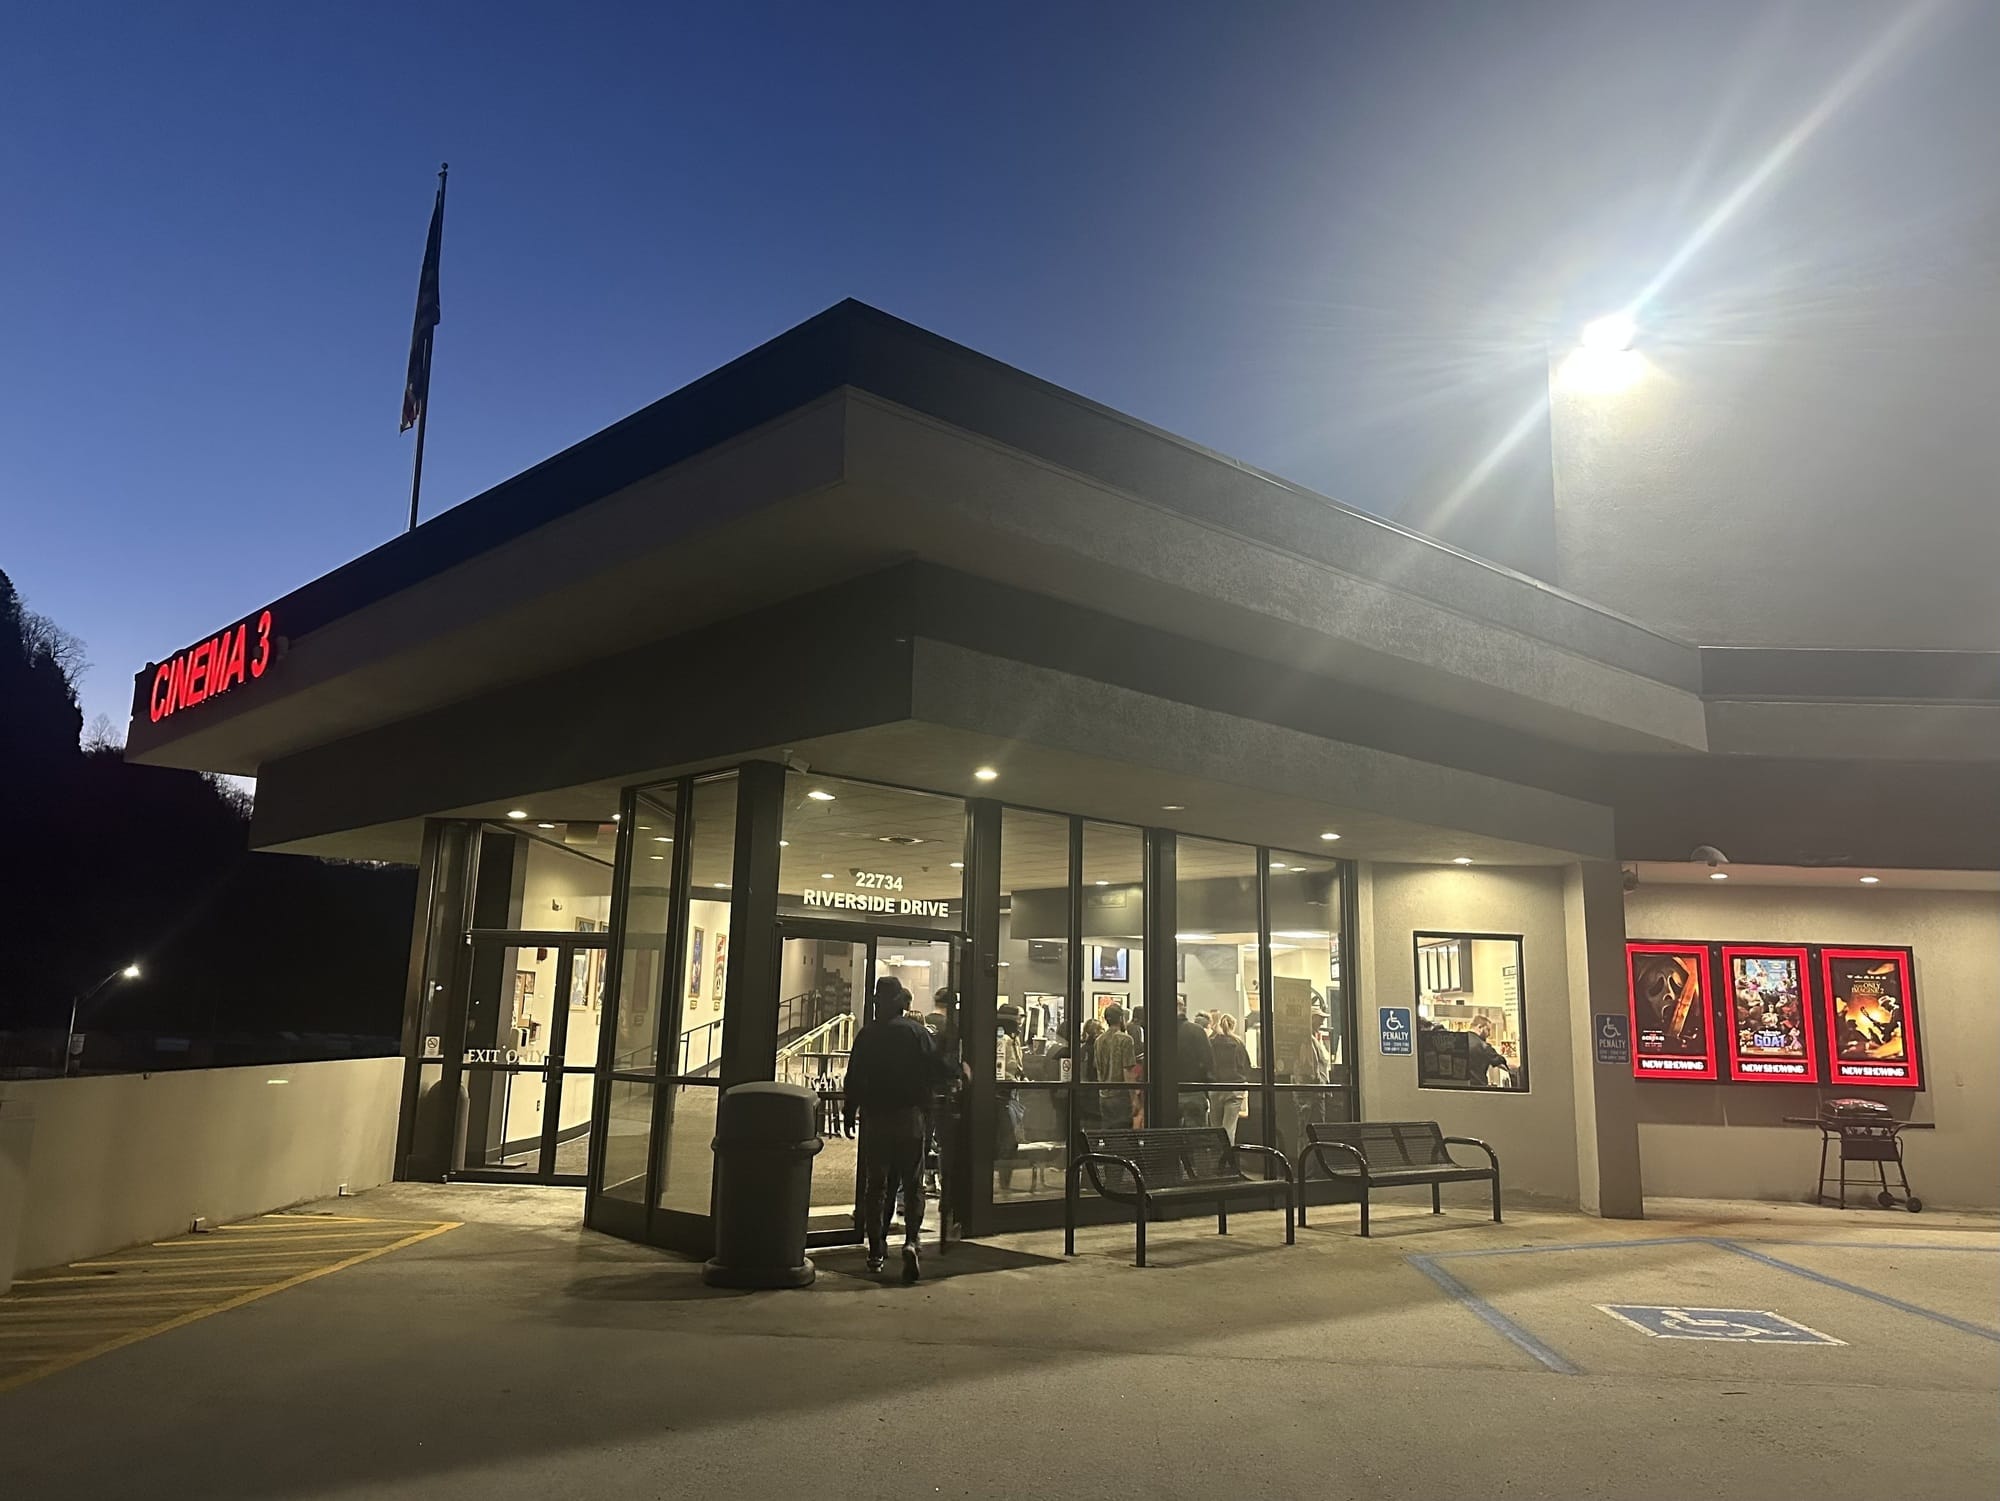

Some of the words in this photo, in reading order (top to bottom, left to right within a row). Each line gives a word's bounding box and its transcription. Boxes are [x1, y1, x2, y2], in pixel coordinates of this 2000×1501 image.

[150, 623, 246, 723] CINEMA
[250, 610, 272, 678] 3
[855, 871, 903, 892] 22734
[803, 888, 895, 914] RIVERSIDE
[900, 898, 949, 918] DRIVE
[1382, 1031, 1409, 1041] PENALTY
[1754, 1033, 1787, 1048] GOAT
[1599, 1038, 1626, 1049] PENALTY
[467, 1049, 501, 1063] EXIT
[1641, 1059, 1664, 1069] NOW
[1664, 1060, 1704, 1070] SHOWING
[1741, 1063, 1763, 1072] NOW
[1763, 1064, 1805, 1074] SHOWING
[1841, 1066, 1863, 1075] NOW
[1863, 1067, 1904, 1076] SHOWING
[777, 1071, 844, 1092] ENTRAN
